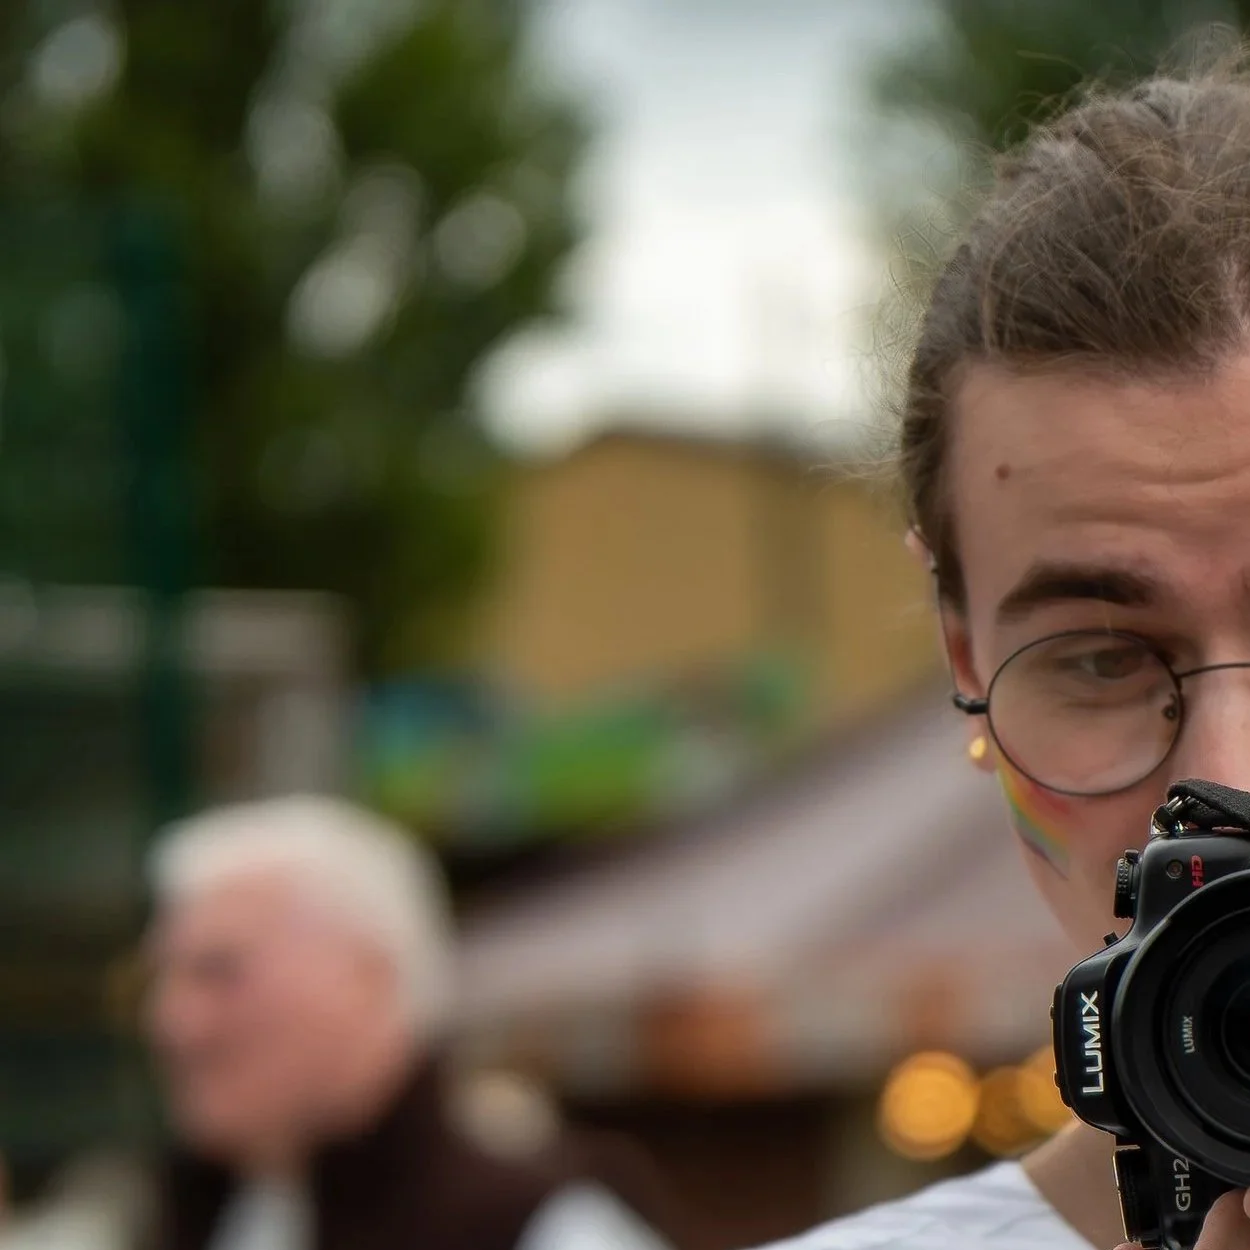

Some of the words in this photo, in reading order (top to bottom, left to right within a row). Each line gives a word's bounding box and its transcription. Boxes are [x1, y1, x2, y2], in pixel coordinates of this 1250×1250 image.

[1191, 855, 1204, 888] HD
[1080, 990, 1104, 1093] LUMIX
[1182, 1016, 1195, 1053] LUMIX
[1173, 1158, 1191, 1211] GH2
